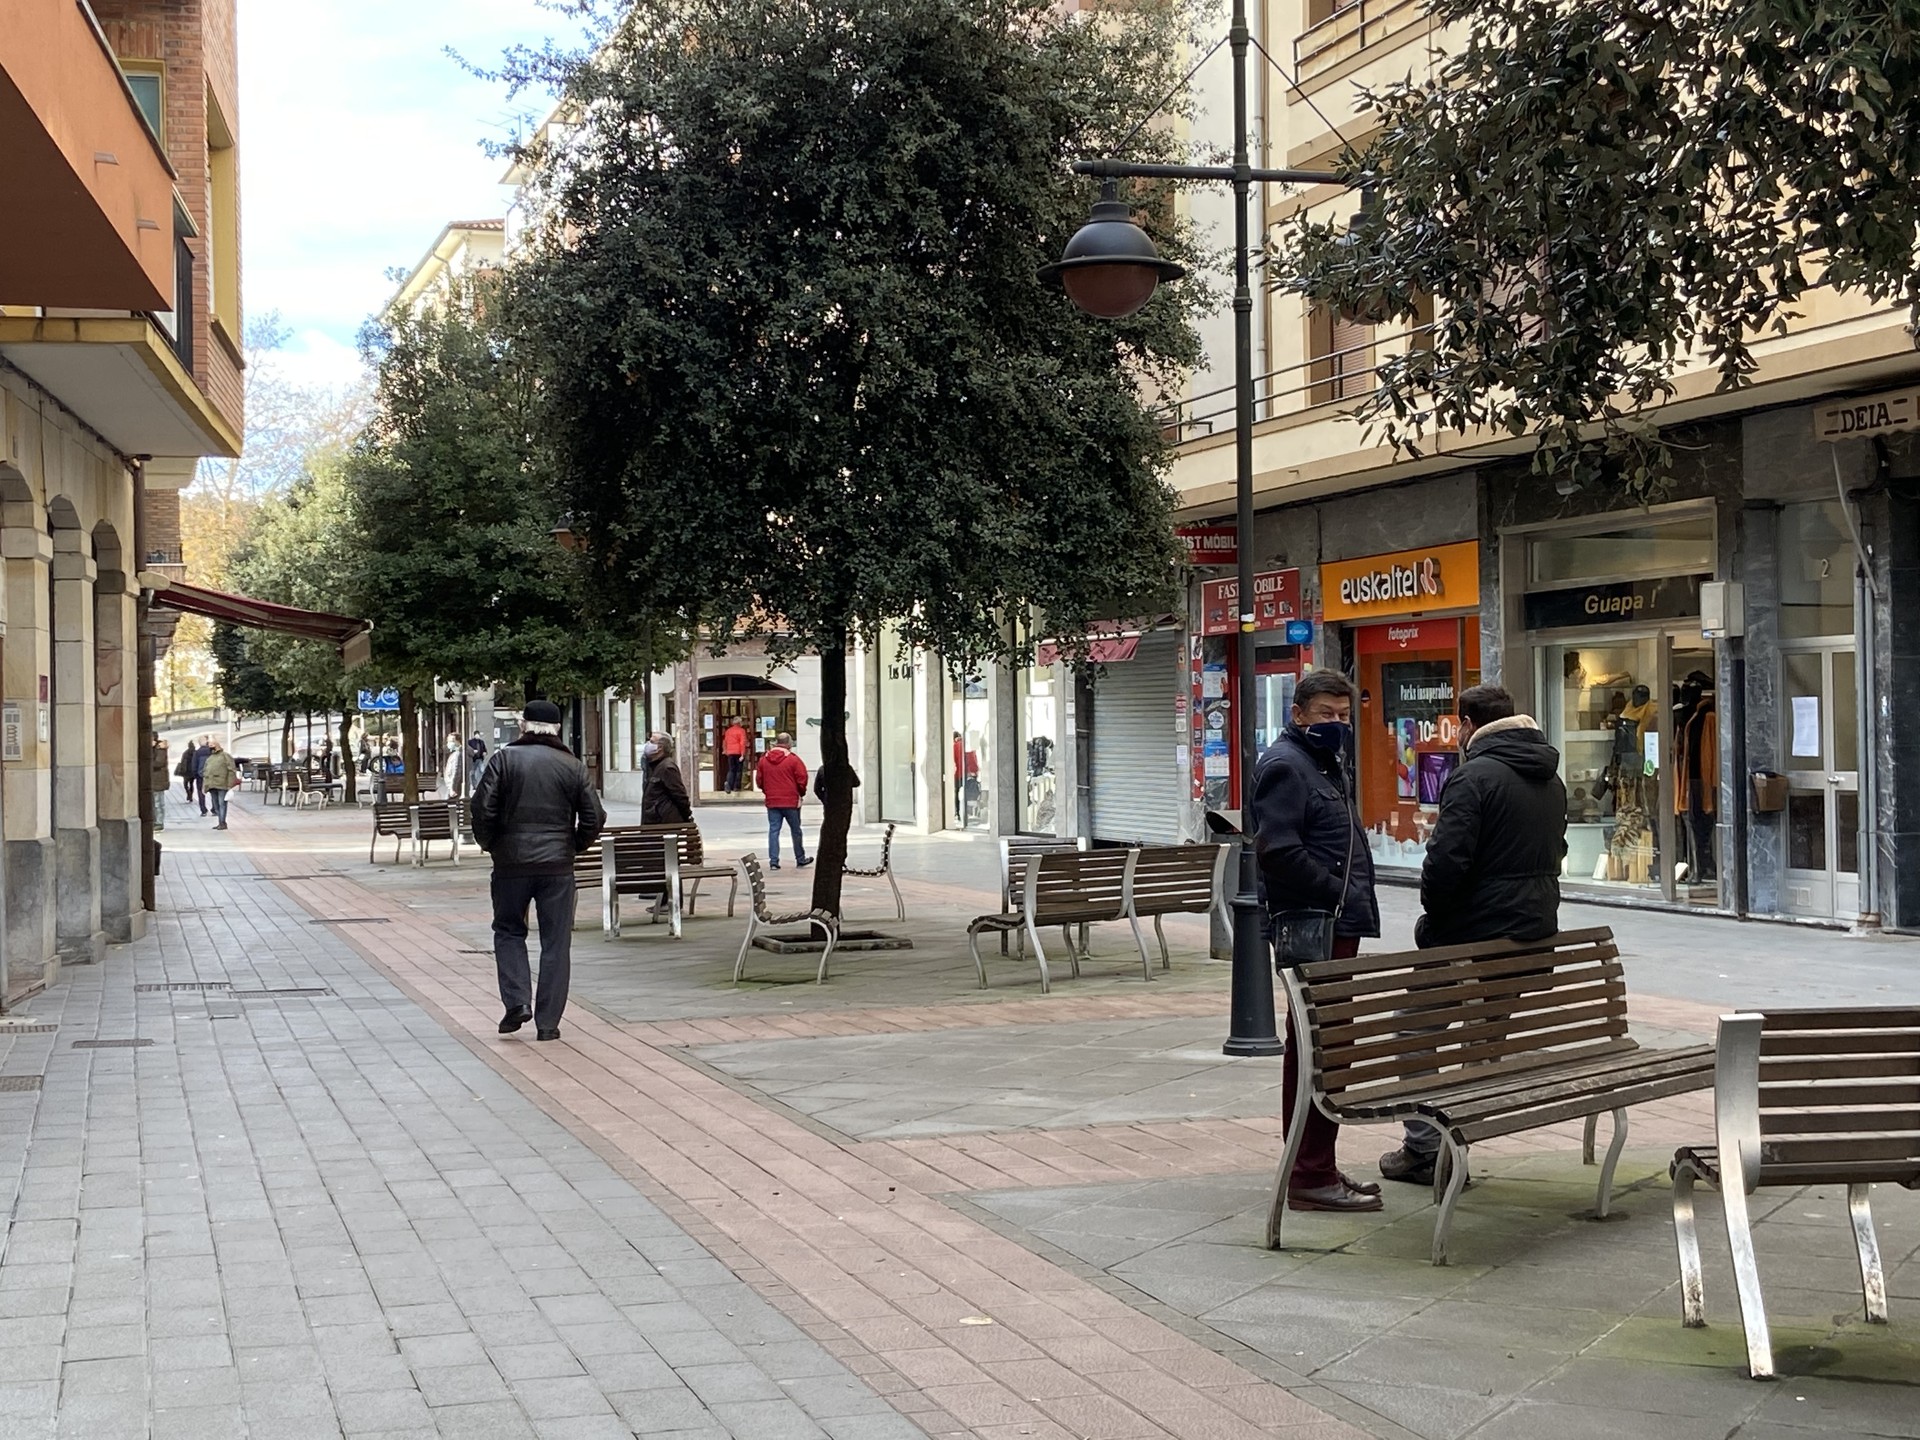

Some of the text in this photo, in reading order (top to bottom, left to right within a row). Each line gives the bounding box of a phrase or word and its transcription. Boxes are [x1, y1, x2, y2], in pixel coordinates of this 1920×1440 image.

[1840, 402, 1892, 433] DEIA
[1203, 533, 1238, 549] MÓBIL
[1821, 558, 1829, 578] 2
[1218, 582, 1239, 600] FAST
[1341, 561, 1418, 605] euskaltel
[1584, 595, 1644, 616] Guapa
[1400, 684, 1416, 700] Packs
